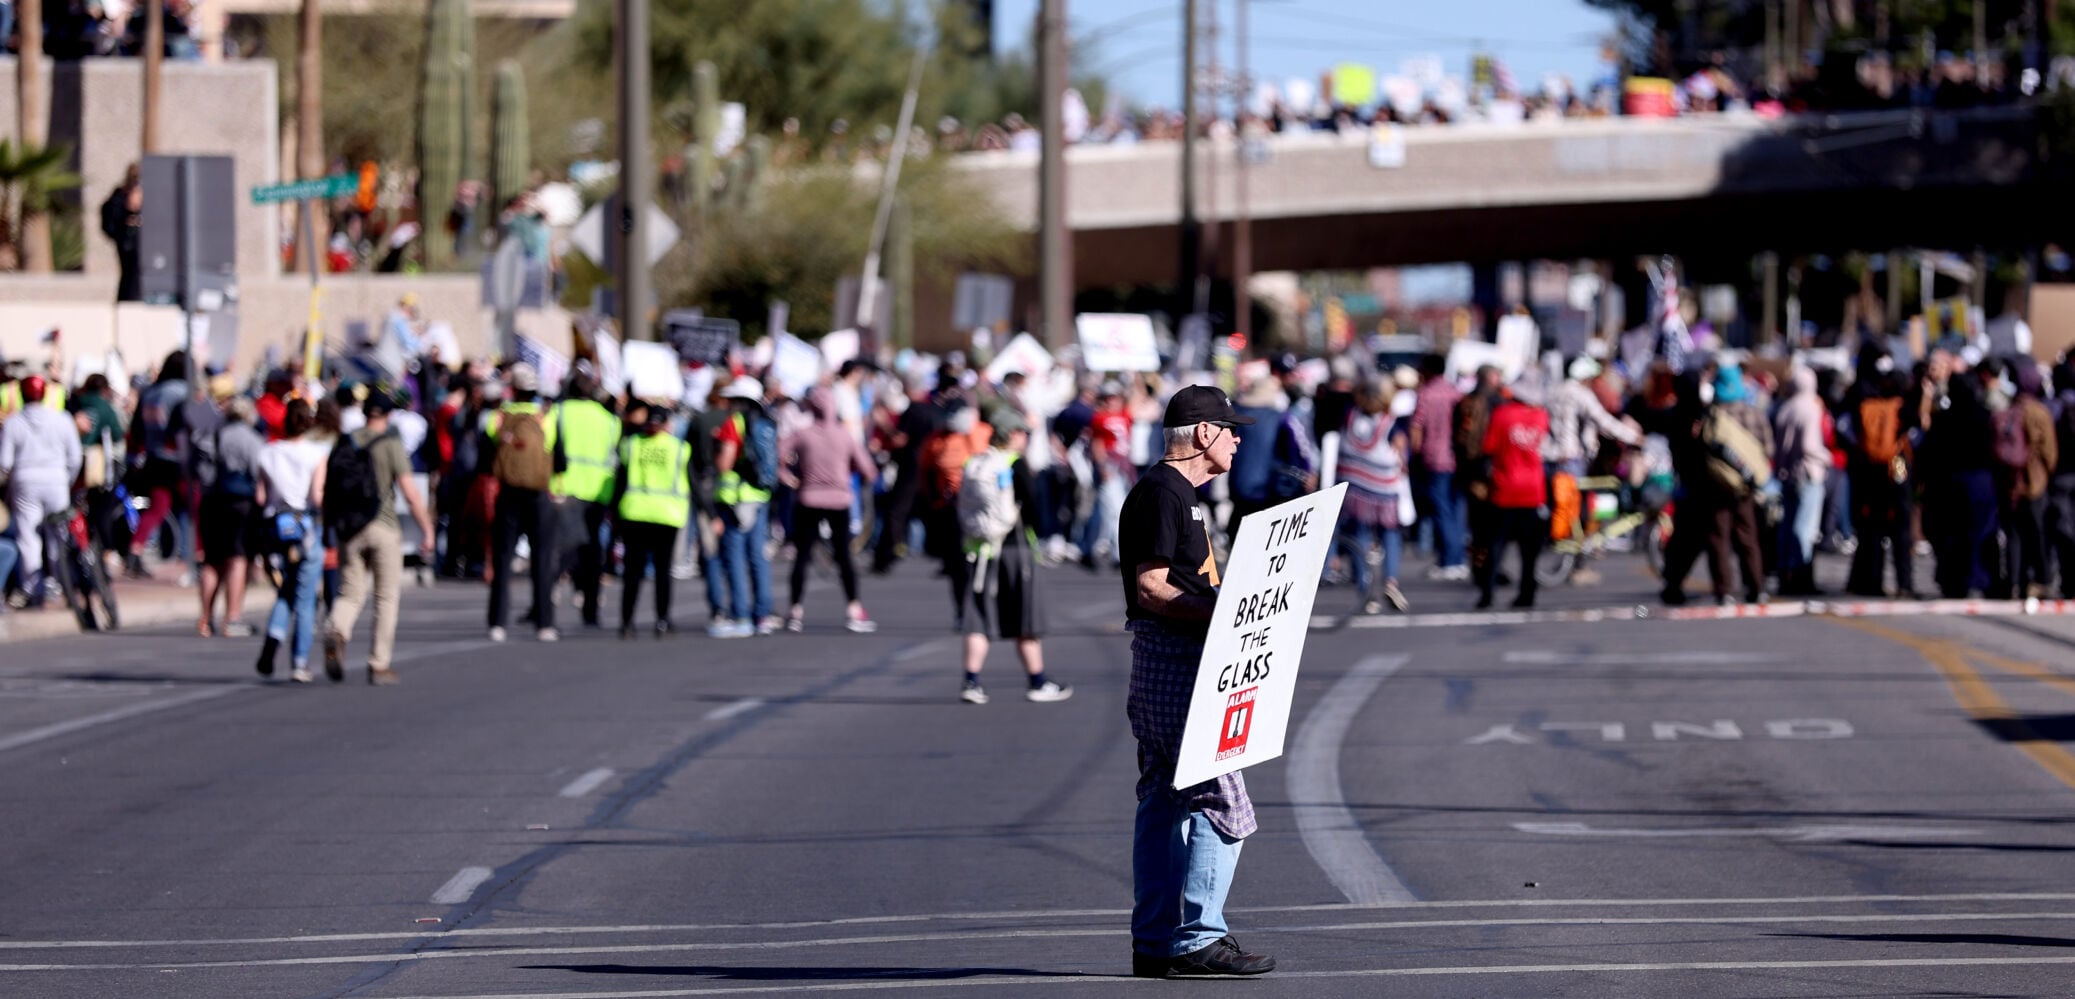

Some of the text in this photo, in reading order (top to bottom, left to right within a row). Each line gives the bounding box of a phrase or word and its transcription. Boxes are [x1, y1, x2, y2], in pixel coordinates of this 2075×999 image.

[1265, 506, 1314, 551] TIME
[1267, 552, 1287, 577] TO
[1233, 581, 1294, 628] BREAK
[1240, 626, 1271, 652] THE
[1217, 651, 1273, 693] GLASS
[1227, 689, 1257, 708] ALARM
[1463, 718, 1854, 744] ONLY
